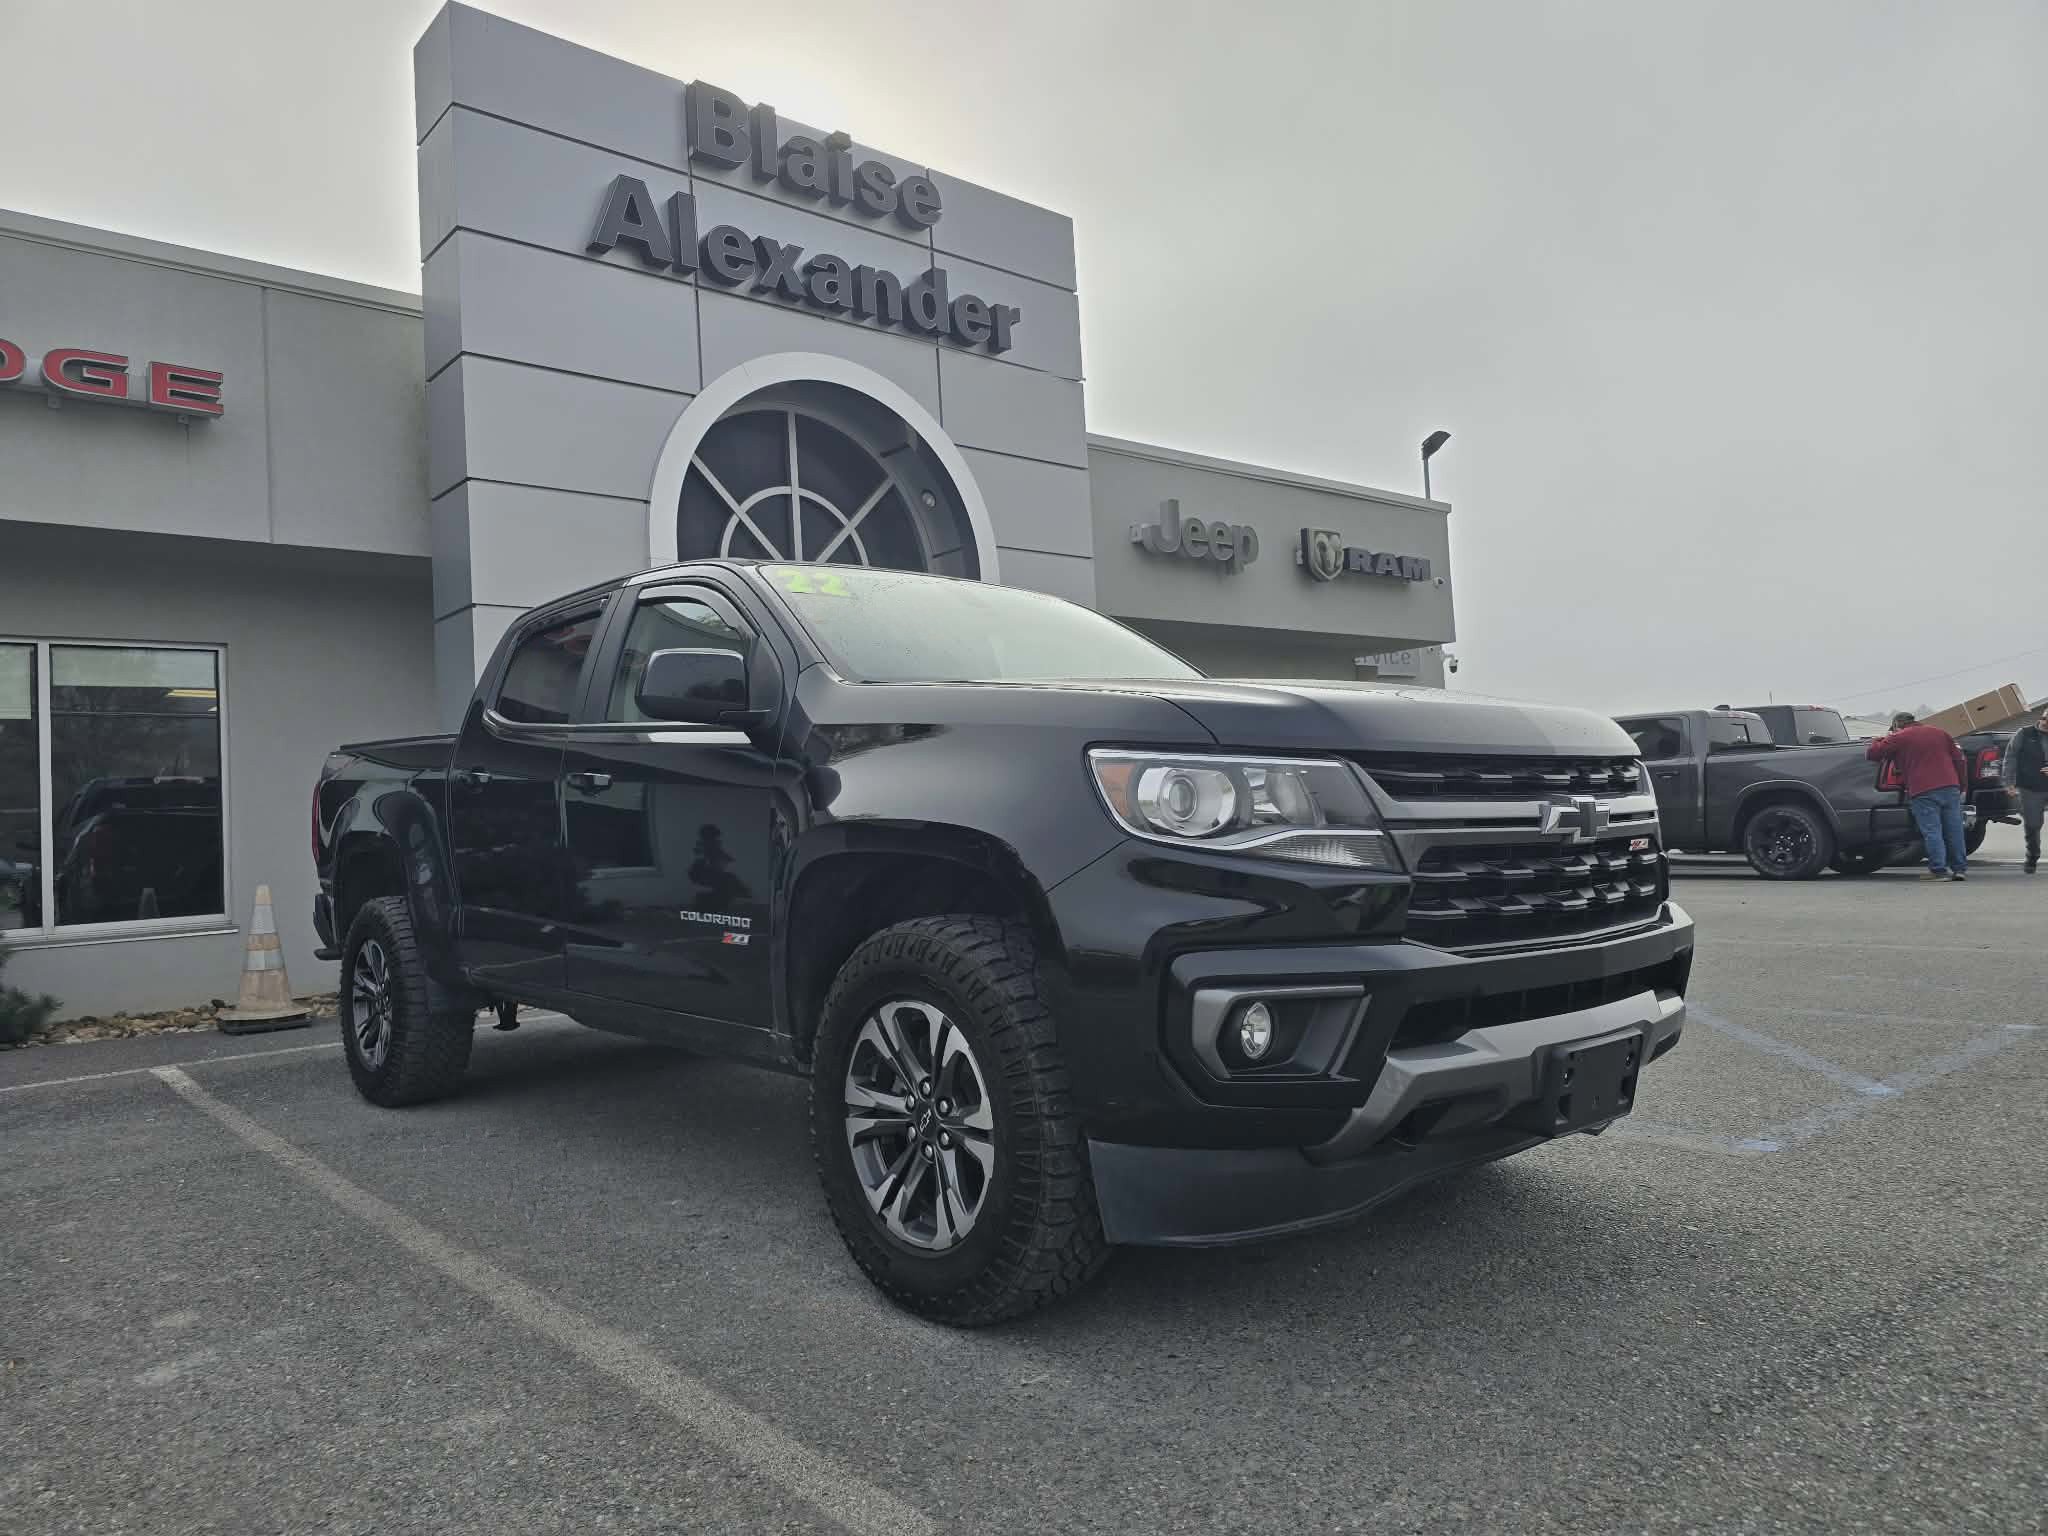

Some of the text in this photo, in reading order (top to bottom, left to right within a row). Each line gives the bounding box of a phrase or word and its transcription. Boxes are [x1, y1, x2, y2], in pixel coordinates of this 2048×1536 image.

[685, 79, 943, 230] Blaise
[586, 174, 1021, 354] Alexander
[1141, 498, 1260, 575] Jeep
[1343, 547, 1431, 582] RAM
[1352, 650, 1412, 667] ervice
[679, 910, 752, 929] COLORADO
